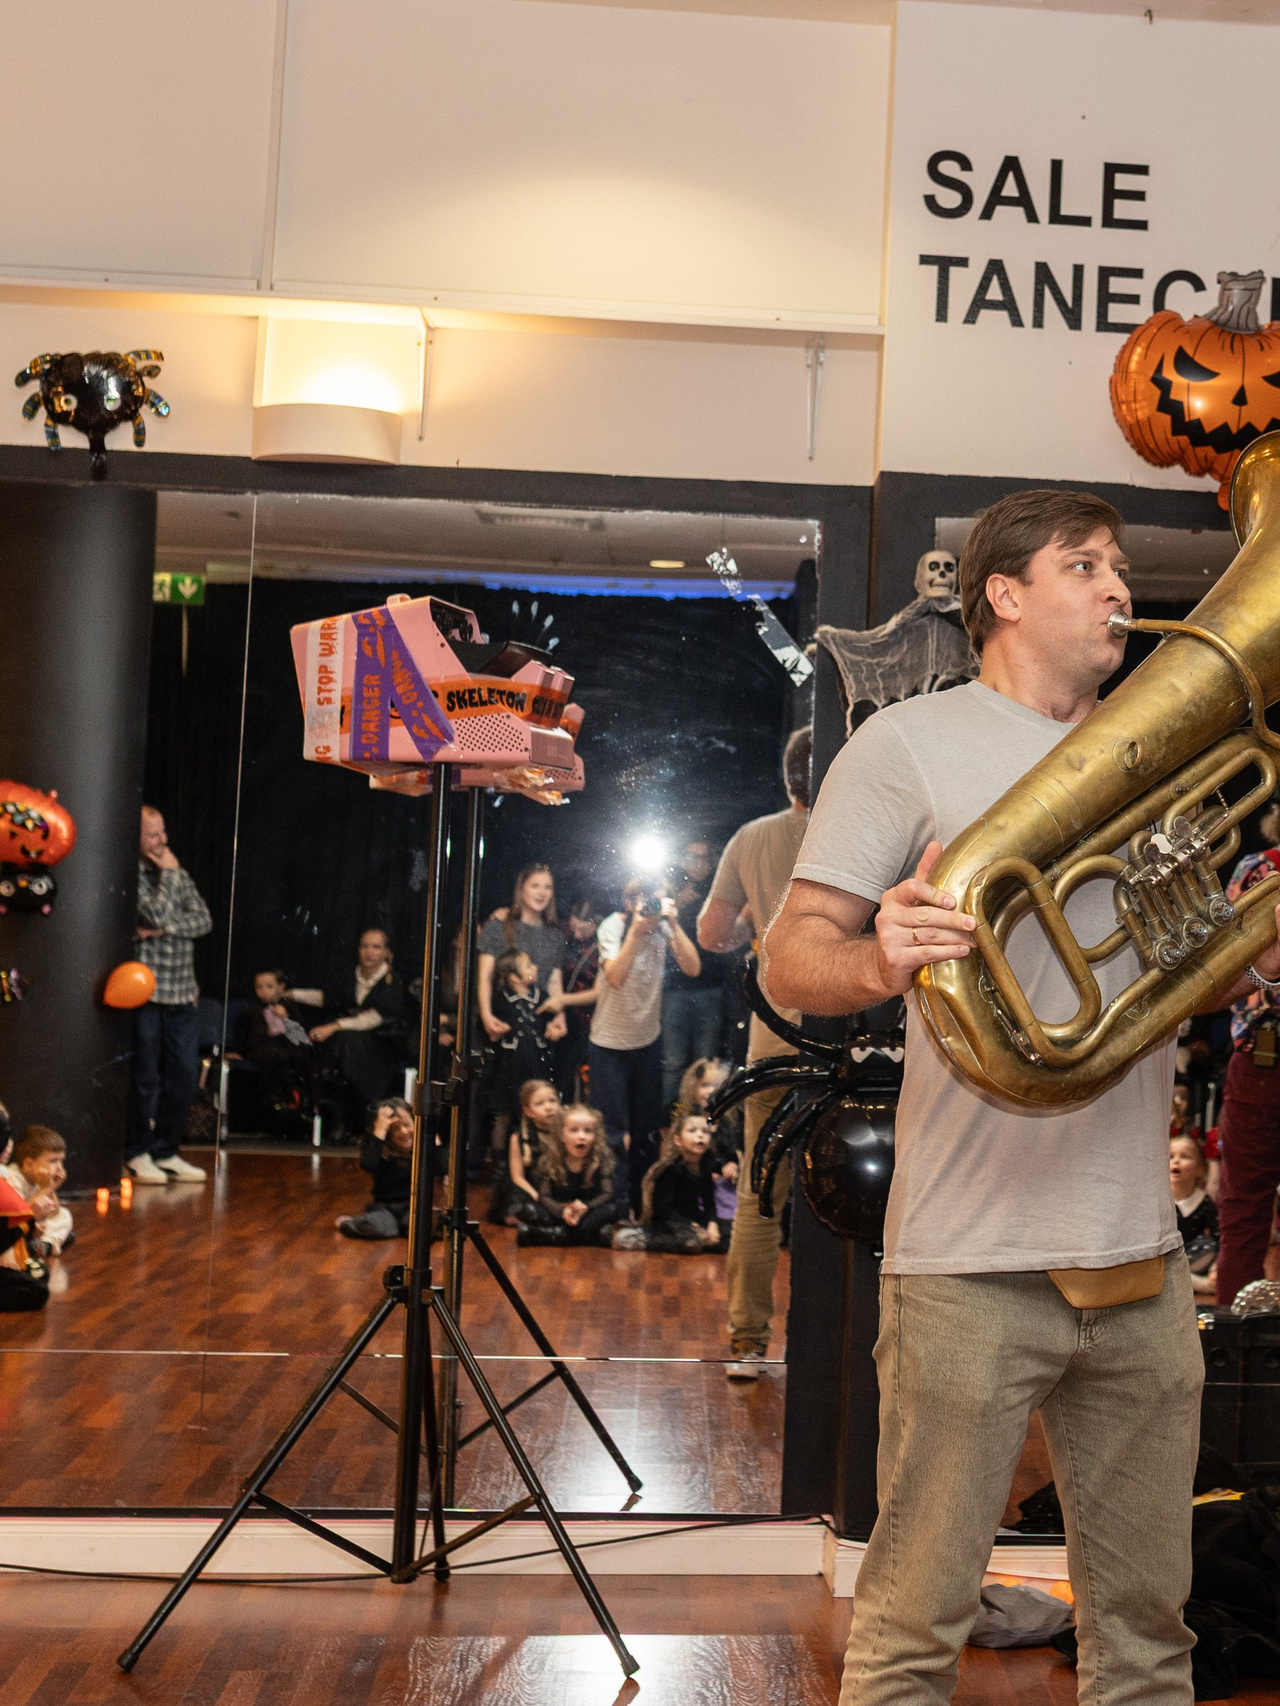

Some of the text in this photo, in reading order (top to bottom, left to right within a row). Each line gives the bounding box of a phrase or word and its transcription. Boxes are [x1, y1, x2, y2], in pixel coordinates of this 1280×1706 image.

[922, 149, 1150, 231] SALE
[317, 664, 337, 706] STOP
[360, 674, 383, 744] DANGER
[446, 687, 527, 713] SKELETON
